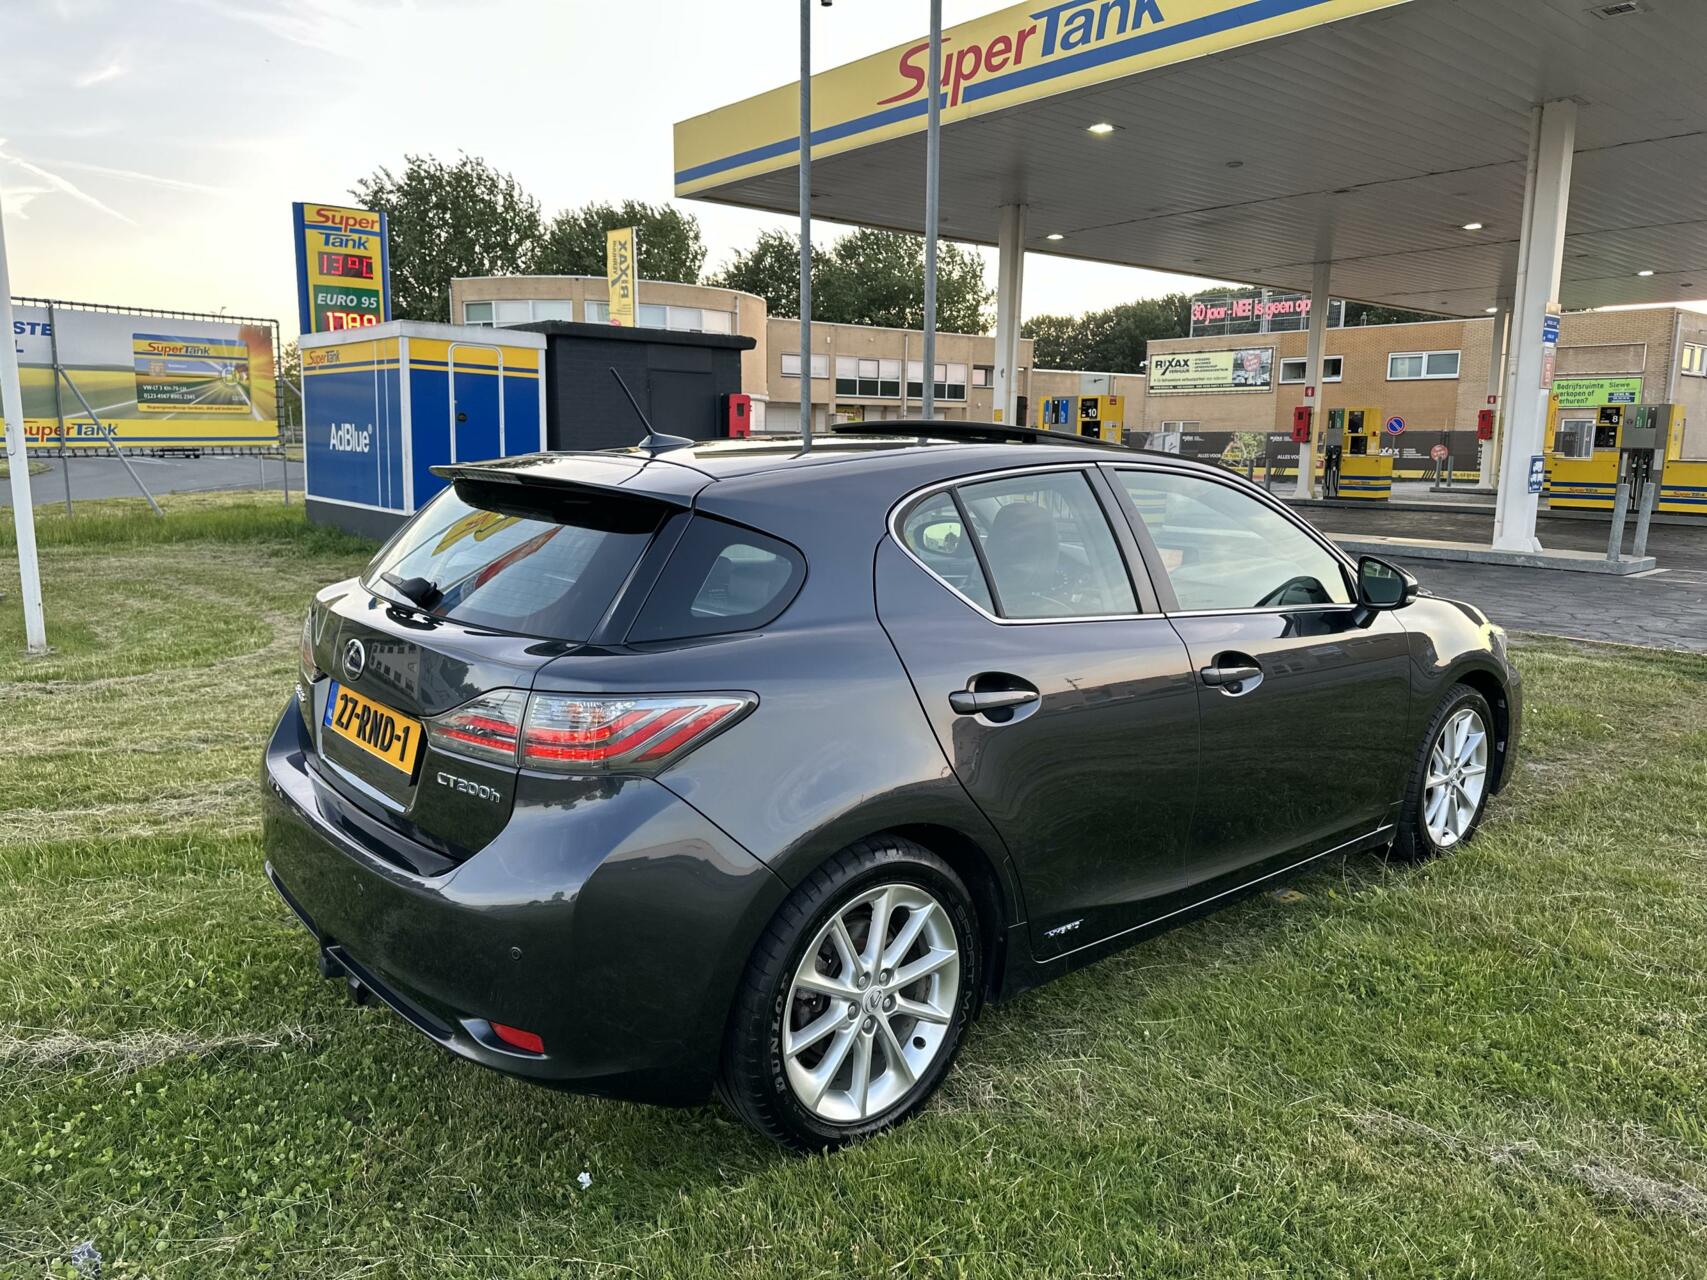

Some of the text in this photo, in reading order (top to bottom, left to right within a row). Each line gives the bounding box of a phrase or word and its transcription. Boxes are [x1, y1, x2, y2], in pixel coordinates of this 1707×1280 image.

[306, 208, 379, 233] Super
[318, 232, 369, 251] Tank
[318, 293, 377, 308] EURO 95
[1205, 305, 1227, 325] jaar
[1254, 299, 1264, 315] is
[1265, 301, 1294, 320] geen
[1155, 357, 1190, 376] RIXAX
[1088, 408, 1097, 417] 10
[1612, 415, 1619, 423] 8
[335, 693, 411, 763] 27-RND-1
[437, 771, 501, 804] CT200h
